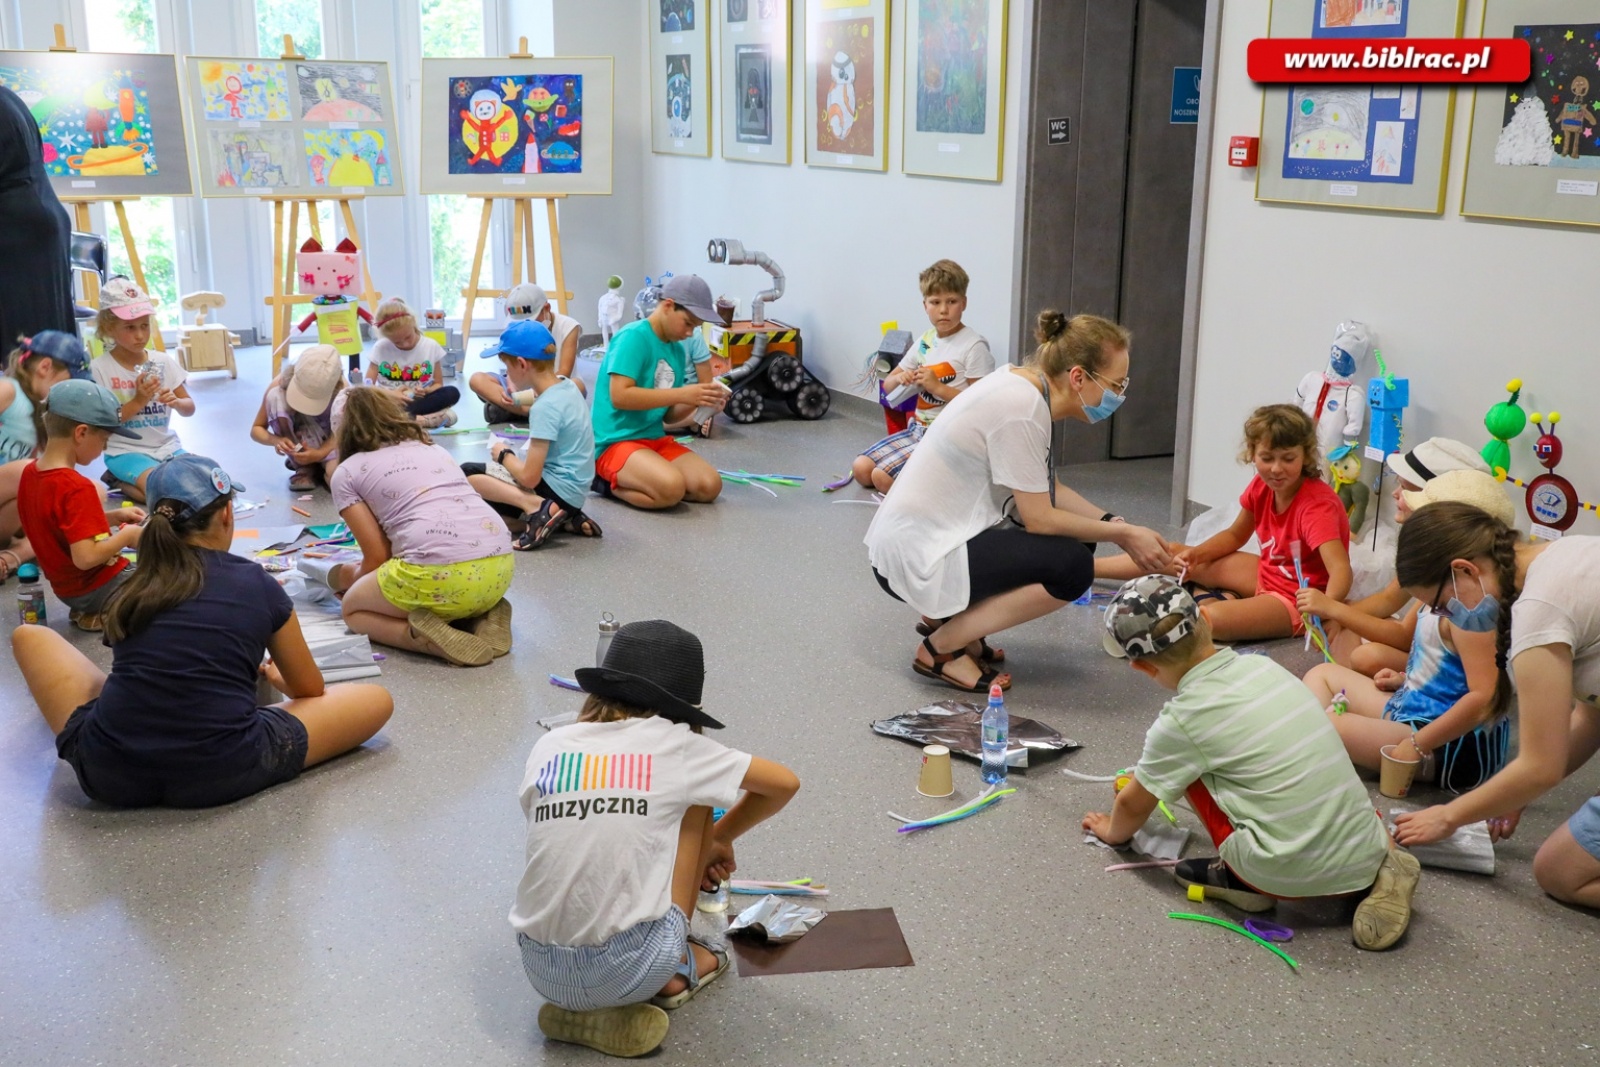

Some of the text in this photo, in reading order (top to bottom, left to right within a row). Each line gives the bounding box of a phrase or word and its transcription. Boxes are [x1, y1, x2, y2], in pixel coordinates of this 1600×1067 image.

[1051, 121, 1066, 130] WC
[384, 466, 418, 477] UNICORN
[425, 529, 459, 538] UNICORN
[535, 797, 648, 822] muzyczna
